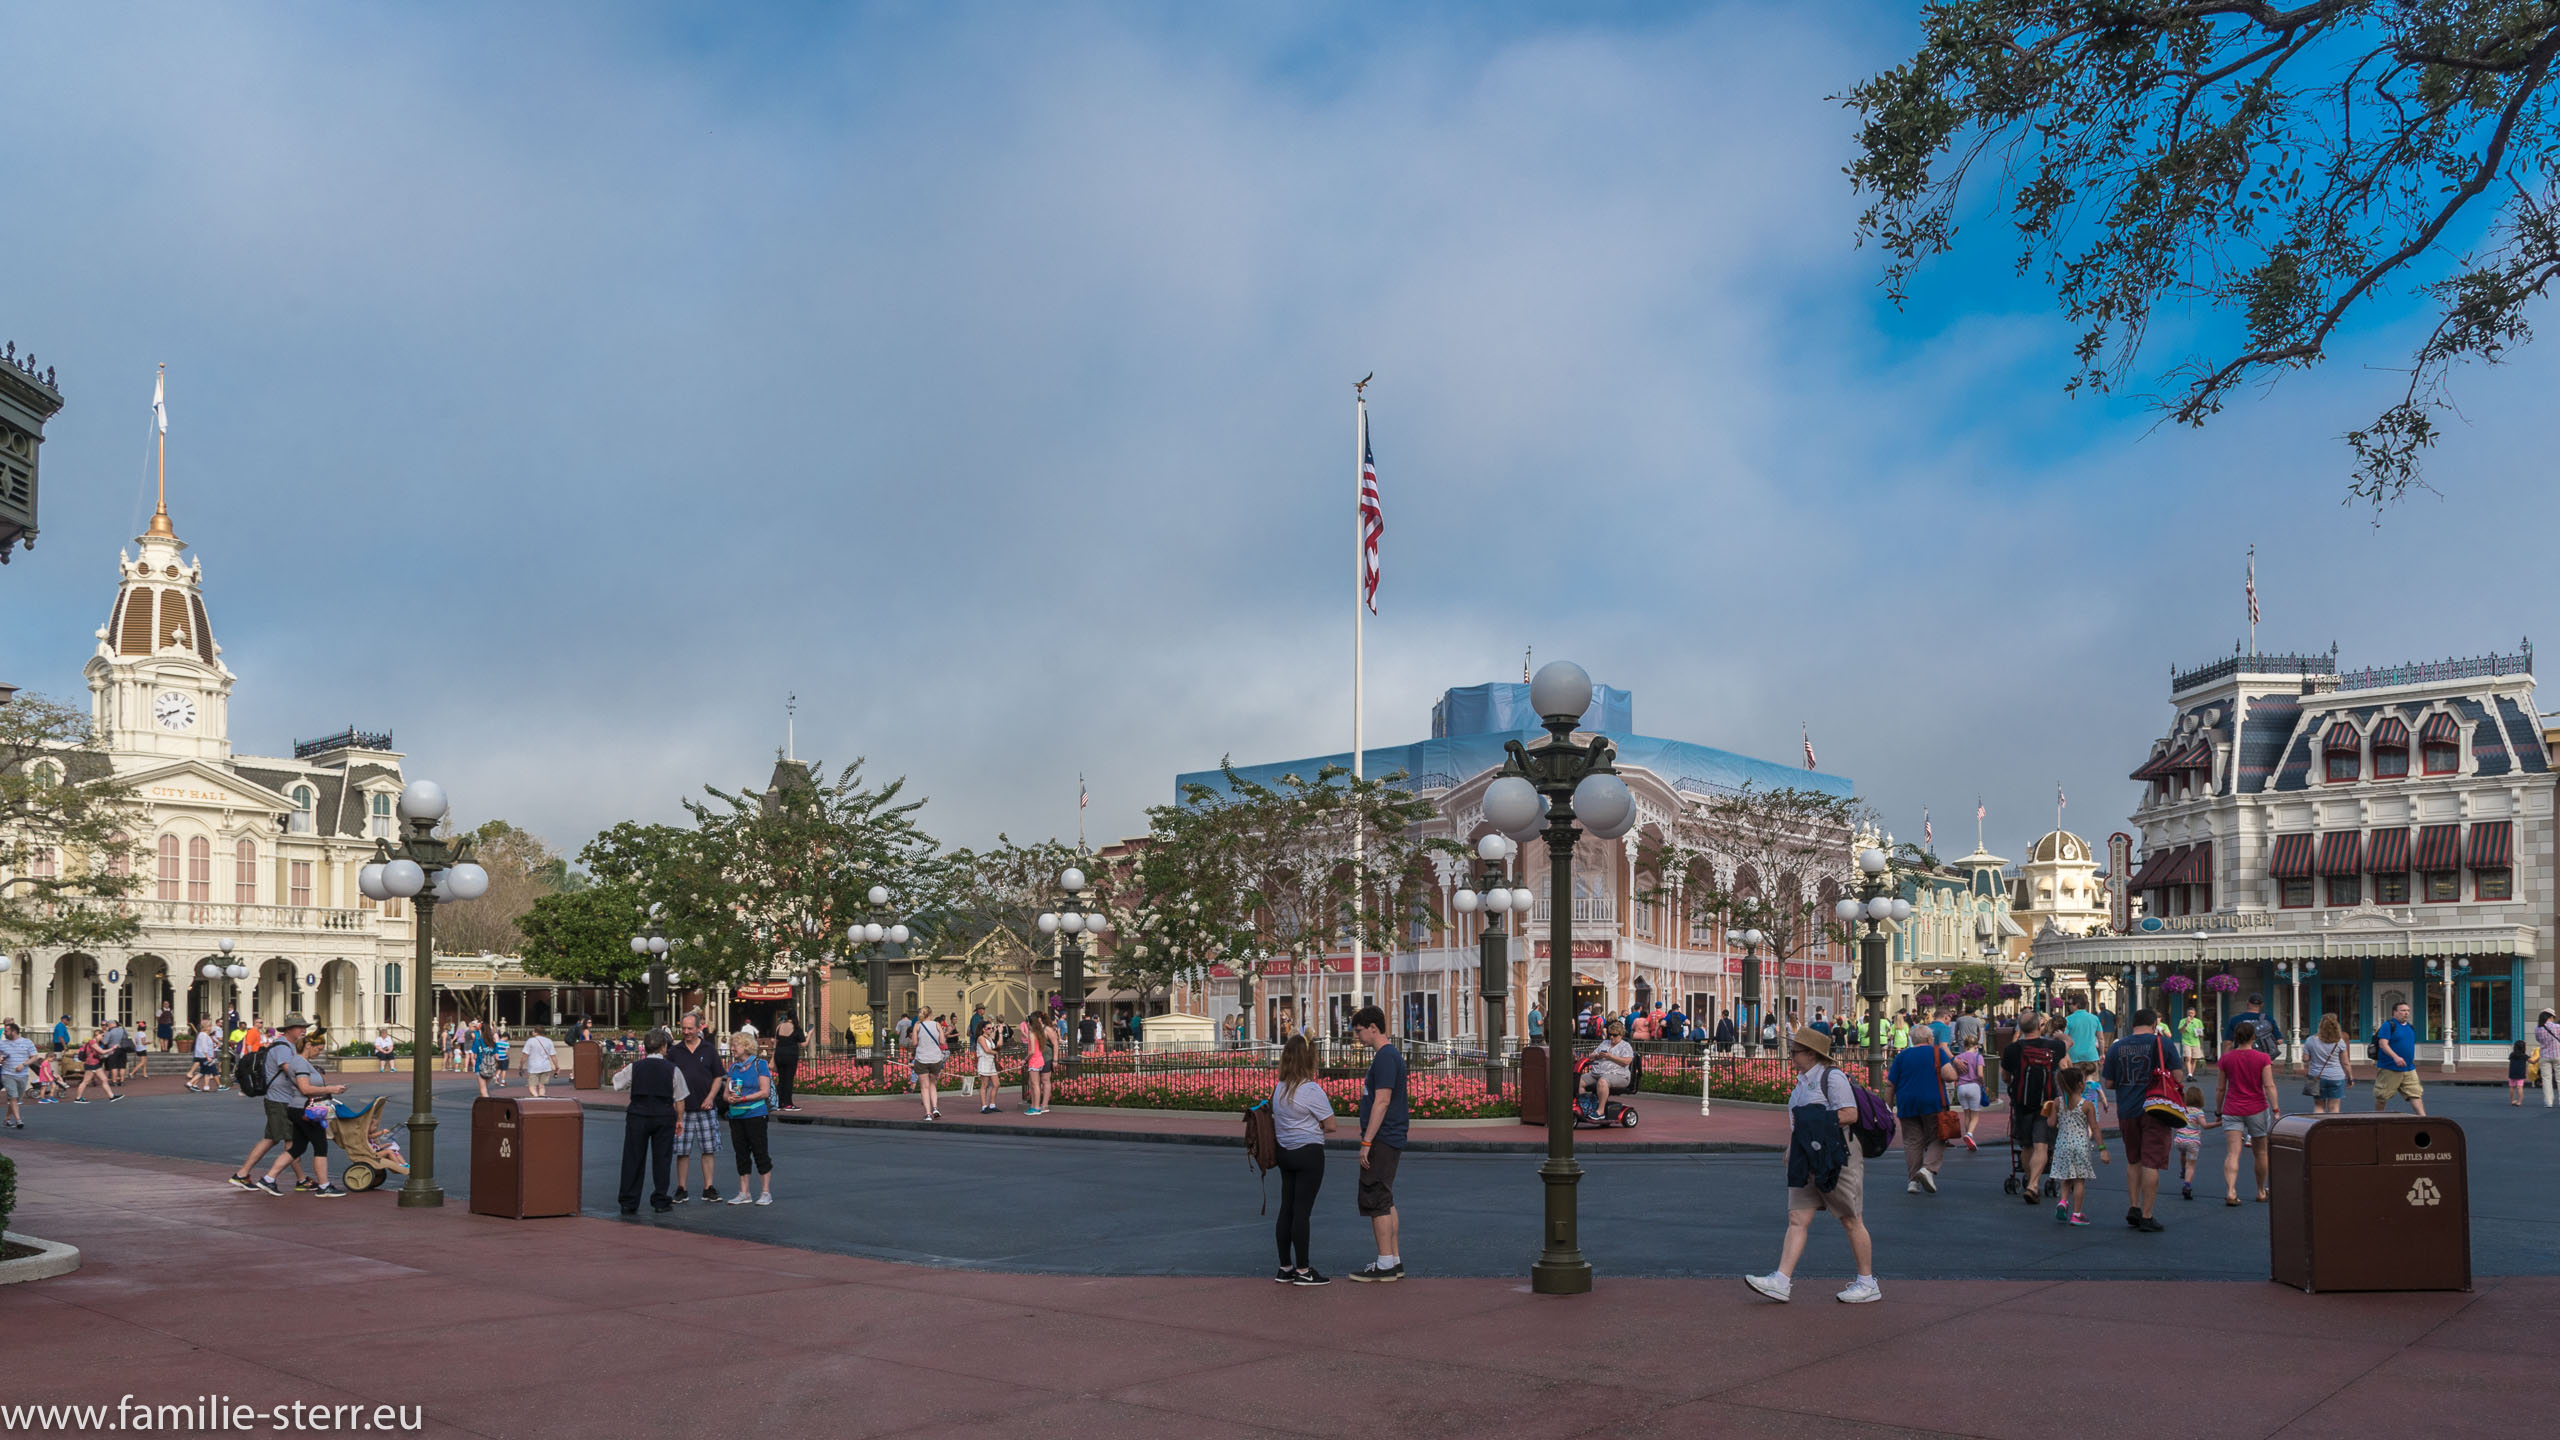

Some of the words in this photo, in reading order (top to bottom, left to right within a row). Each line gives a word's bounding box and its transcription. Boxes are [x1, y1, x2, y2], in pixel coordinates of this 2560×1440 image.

[152, 787, 184, 797] CITY
[189, 790, 227, 800] HALL
[2163, 912, 2277, 930] CONFECTIONERY
[2119, 1055, 2151, 1086] 12
[2395, 1153, 2423, 1161] BOTTLES
[2436, 1152, 2452, 1160] CANS
